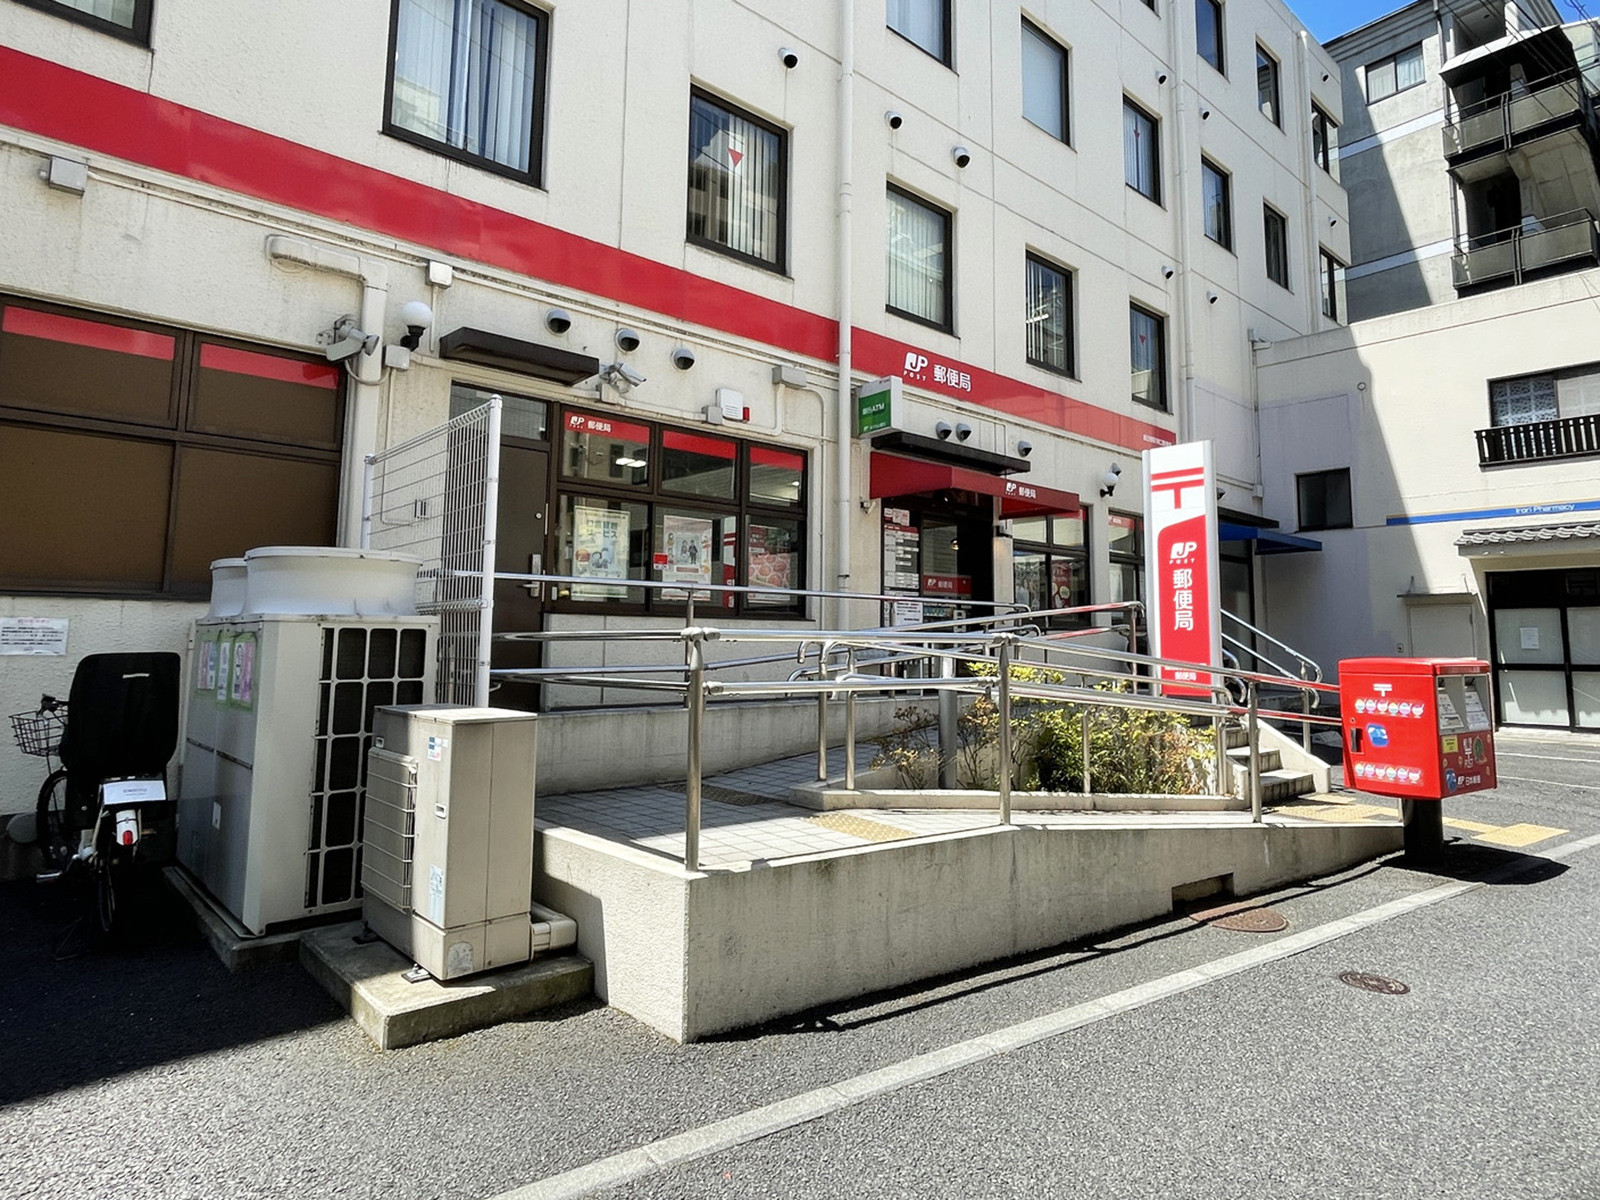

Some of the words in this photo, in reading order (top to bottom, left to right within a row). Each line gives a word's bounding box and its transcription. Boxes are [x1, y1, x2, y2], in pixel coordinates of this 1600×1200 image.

[903, 370, 926, 381] POST
[904, 352, 928, 372] JP
[933, 364, 971, 392] 郵便局
[587, 420, 611, 432] 郵便局
[1018, 486, 1036, 499] 郵便局
[1533, 504, 1575, 513] Pharmacy
[1170, 542, 1197, 559] JP
[1169, 557, 1195, 565] POST
[1172, 568, 1194, 631] 郵便局
[1174, 671, 1197, 681] 郵便局
